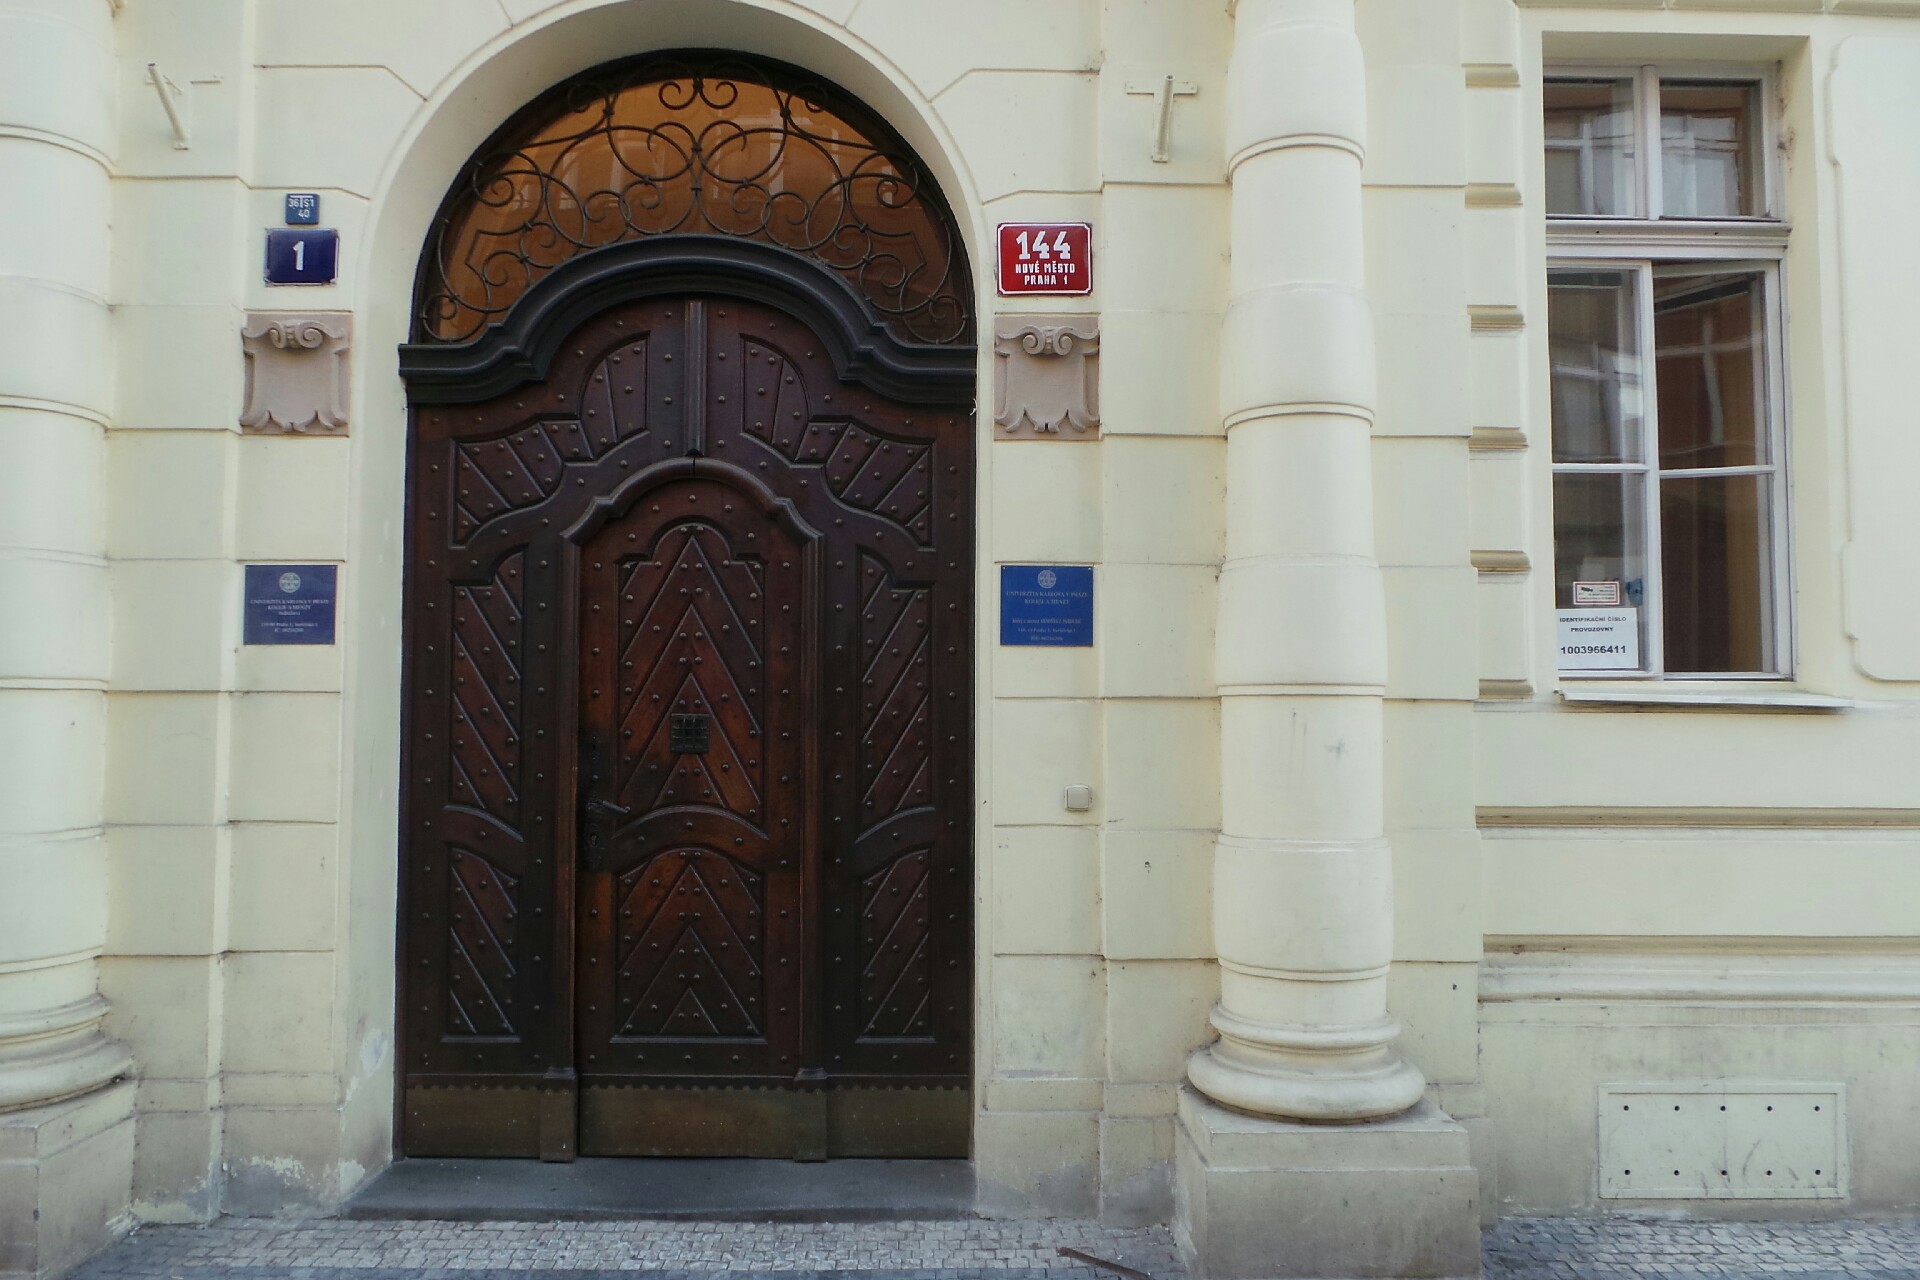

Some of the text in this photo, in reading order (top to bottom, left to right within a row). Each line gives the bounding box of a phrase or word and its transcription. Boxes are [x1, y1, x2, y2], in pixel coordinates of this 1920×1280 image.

[1016, 231, 1071, 260] 144
[292, 240, 304, 271] 1
[1015, 260, 1076, 274] NOVÉ MĚSTO
[1024, 275, 1068, 285] PRAHA 1
[1560, 645, 1626, 655] 1003966411
